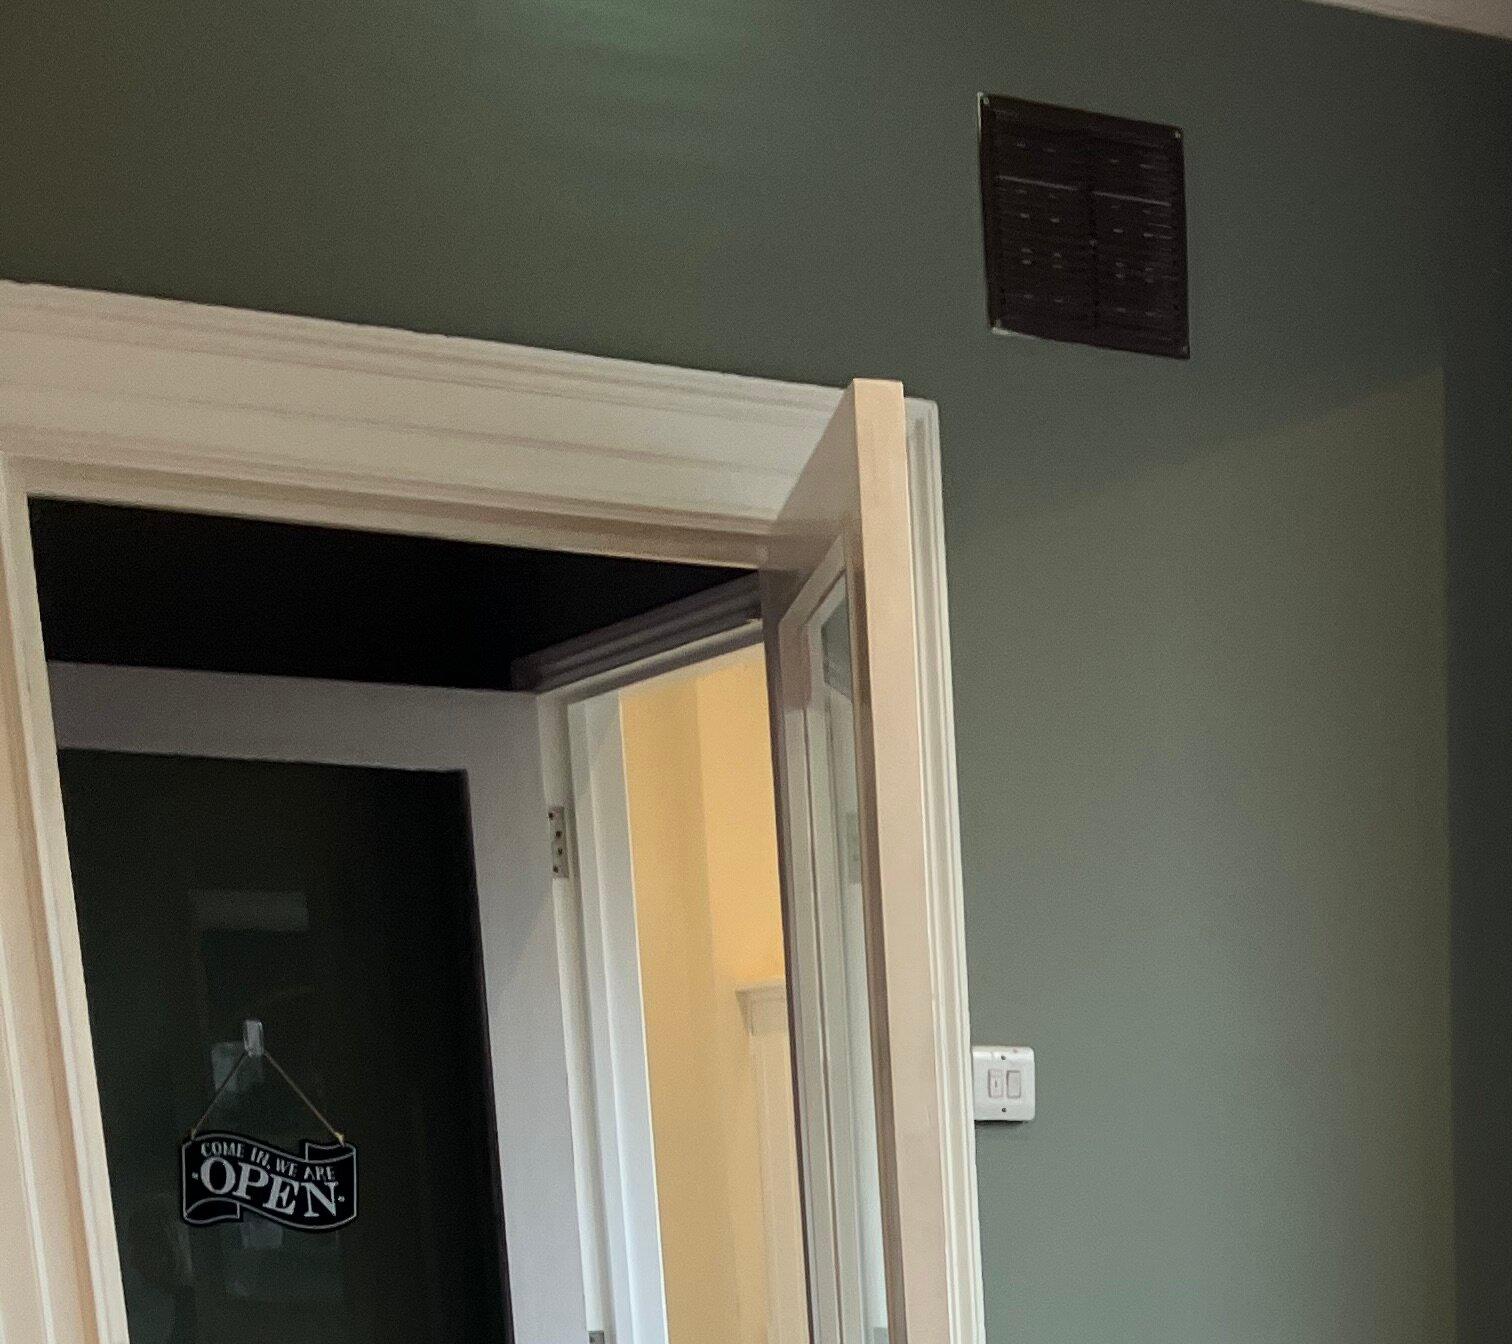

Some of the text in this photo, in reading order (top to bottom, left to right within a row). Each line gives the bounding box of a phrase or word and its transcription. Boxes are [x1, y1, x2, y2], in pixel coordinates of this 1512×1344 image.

[200, 1141, 245, 1158] COME
[275, 1157, 299, 1177] WE
[303, 1166, 336, 1181] ARE
[200, 1156, 339, 1218] OPEN
